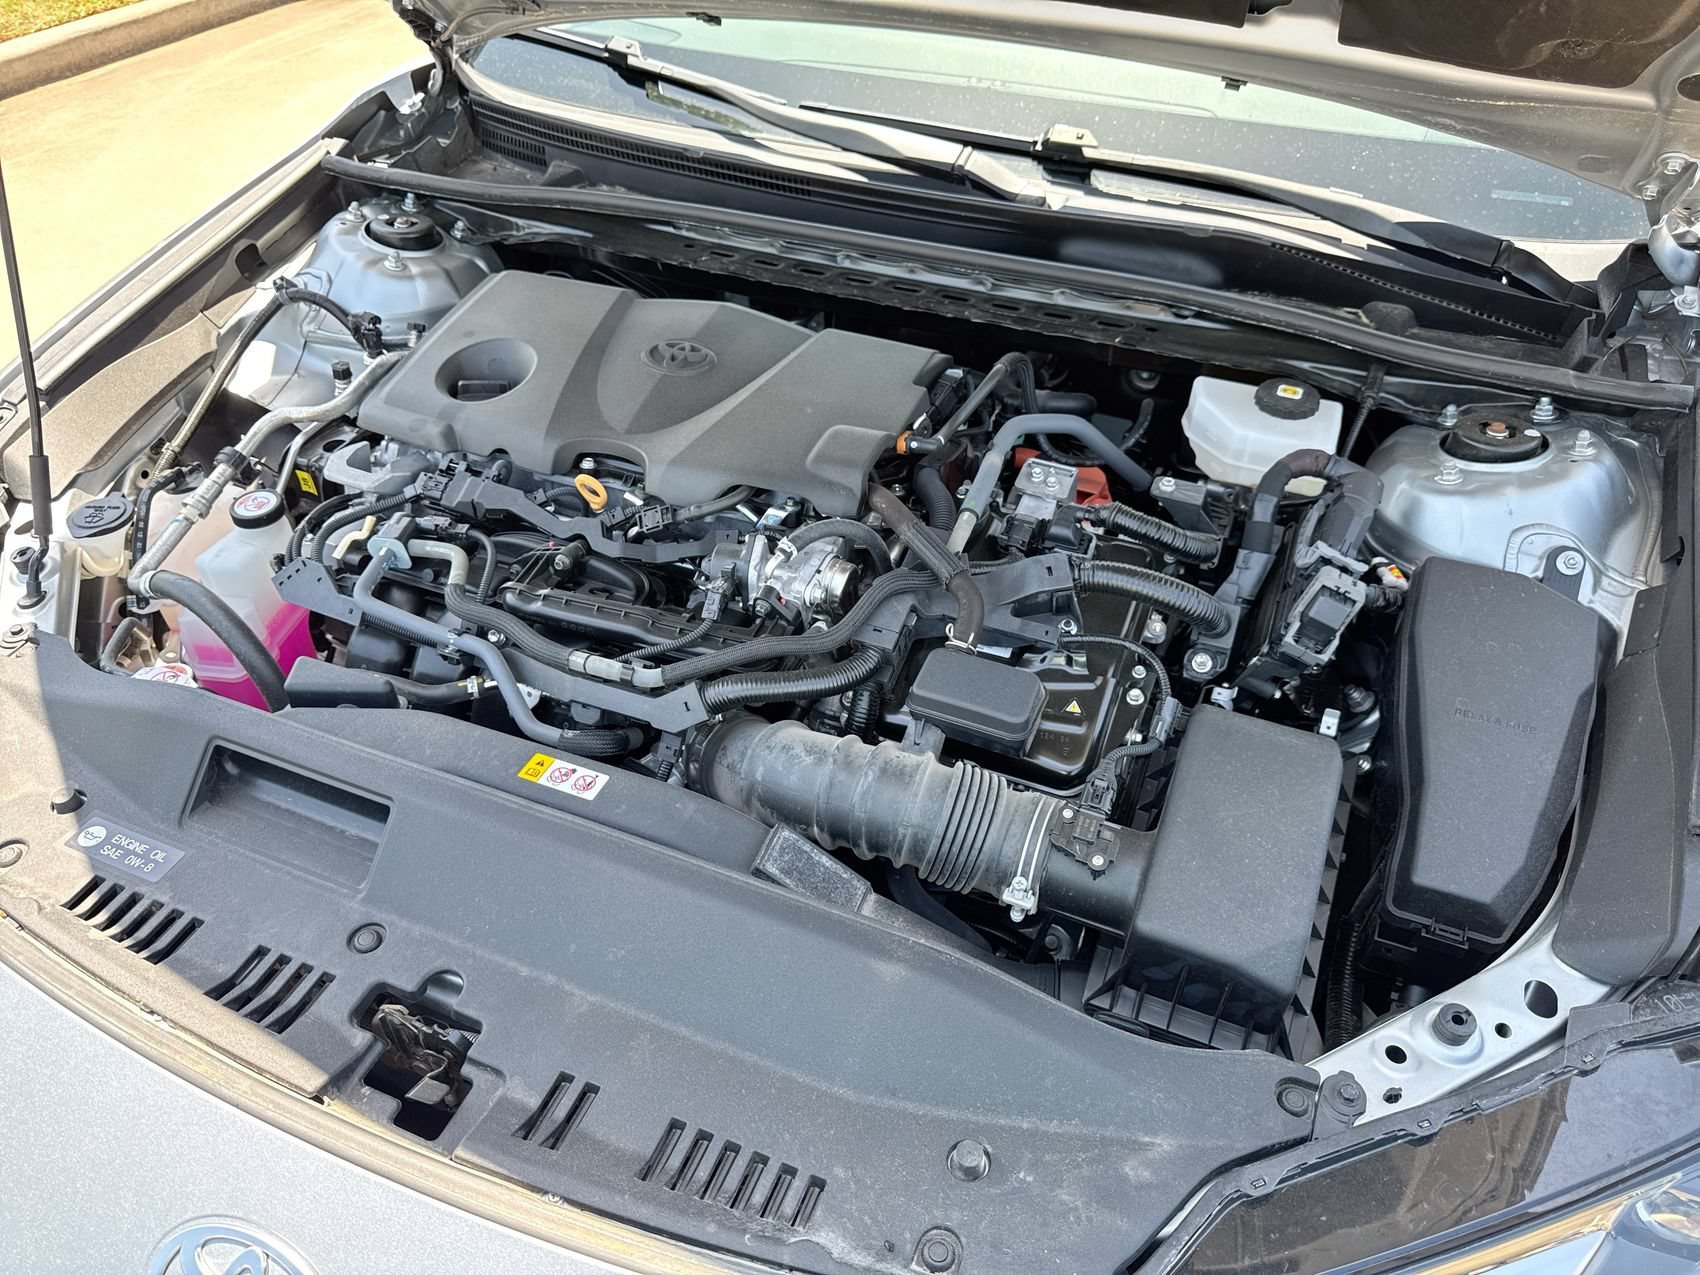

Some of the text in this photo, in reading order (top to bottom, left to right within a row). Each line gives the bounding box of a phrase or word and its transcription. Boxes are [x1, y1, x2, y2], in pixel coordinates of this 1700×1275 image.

[1454, 707, 1493, 724] RELAY
[1505, 720, 1537, 735] FUSE
[100, 845, 155, 873] SAE 0W-8
[111, 834, 169, 863] ENGINE OIL
